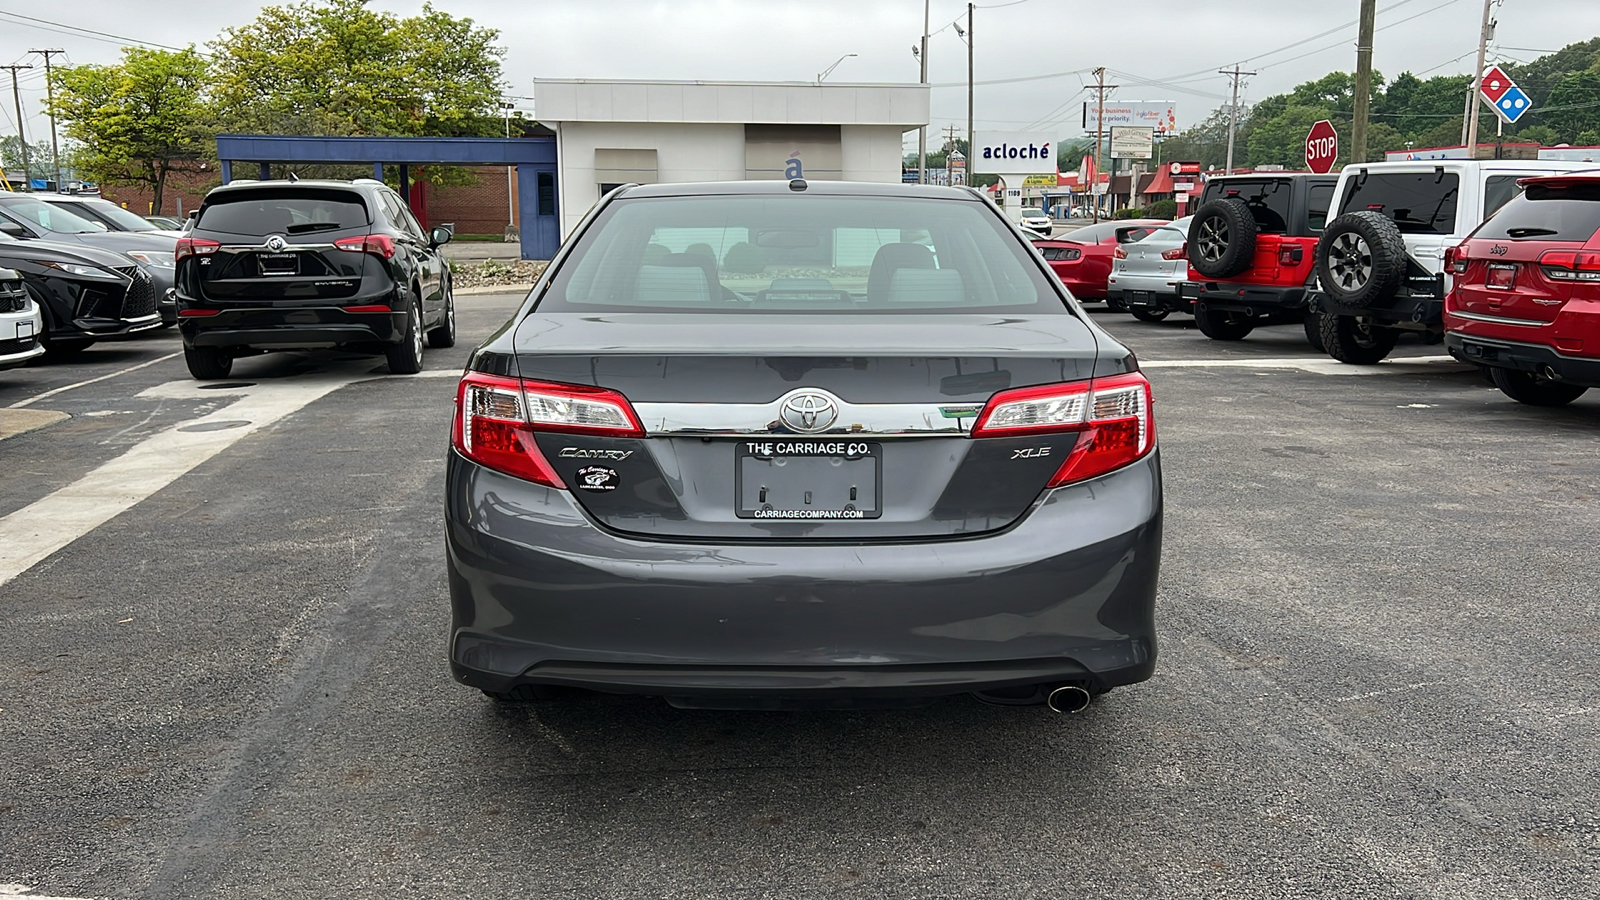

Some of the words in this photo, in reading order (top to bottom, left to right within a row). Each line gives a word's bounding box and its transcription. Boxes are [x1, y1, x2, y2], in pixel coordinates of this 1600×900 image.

[983, 142, 1050, 159] acloché
[1307, 136, 1335, 160] STOP
[1490, 244, 1508, 256] Jeep
[558, 447, 634, 461] CAMRY
[746, 443, 773, 454] THE
[776, 442, 845, 454] CARRIAGE
[847, 443, 871, 454] CO.
[1010, 446, 1052, 460] XLE
[754, 510, 864, 518] CARRIAGECOMPANY.COM
